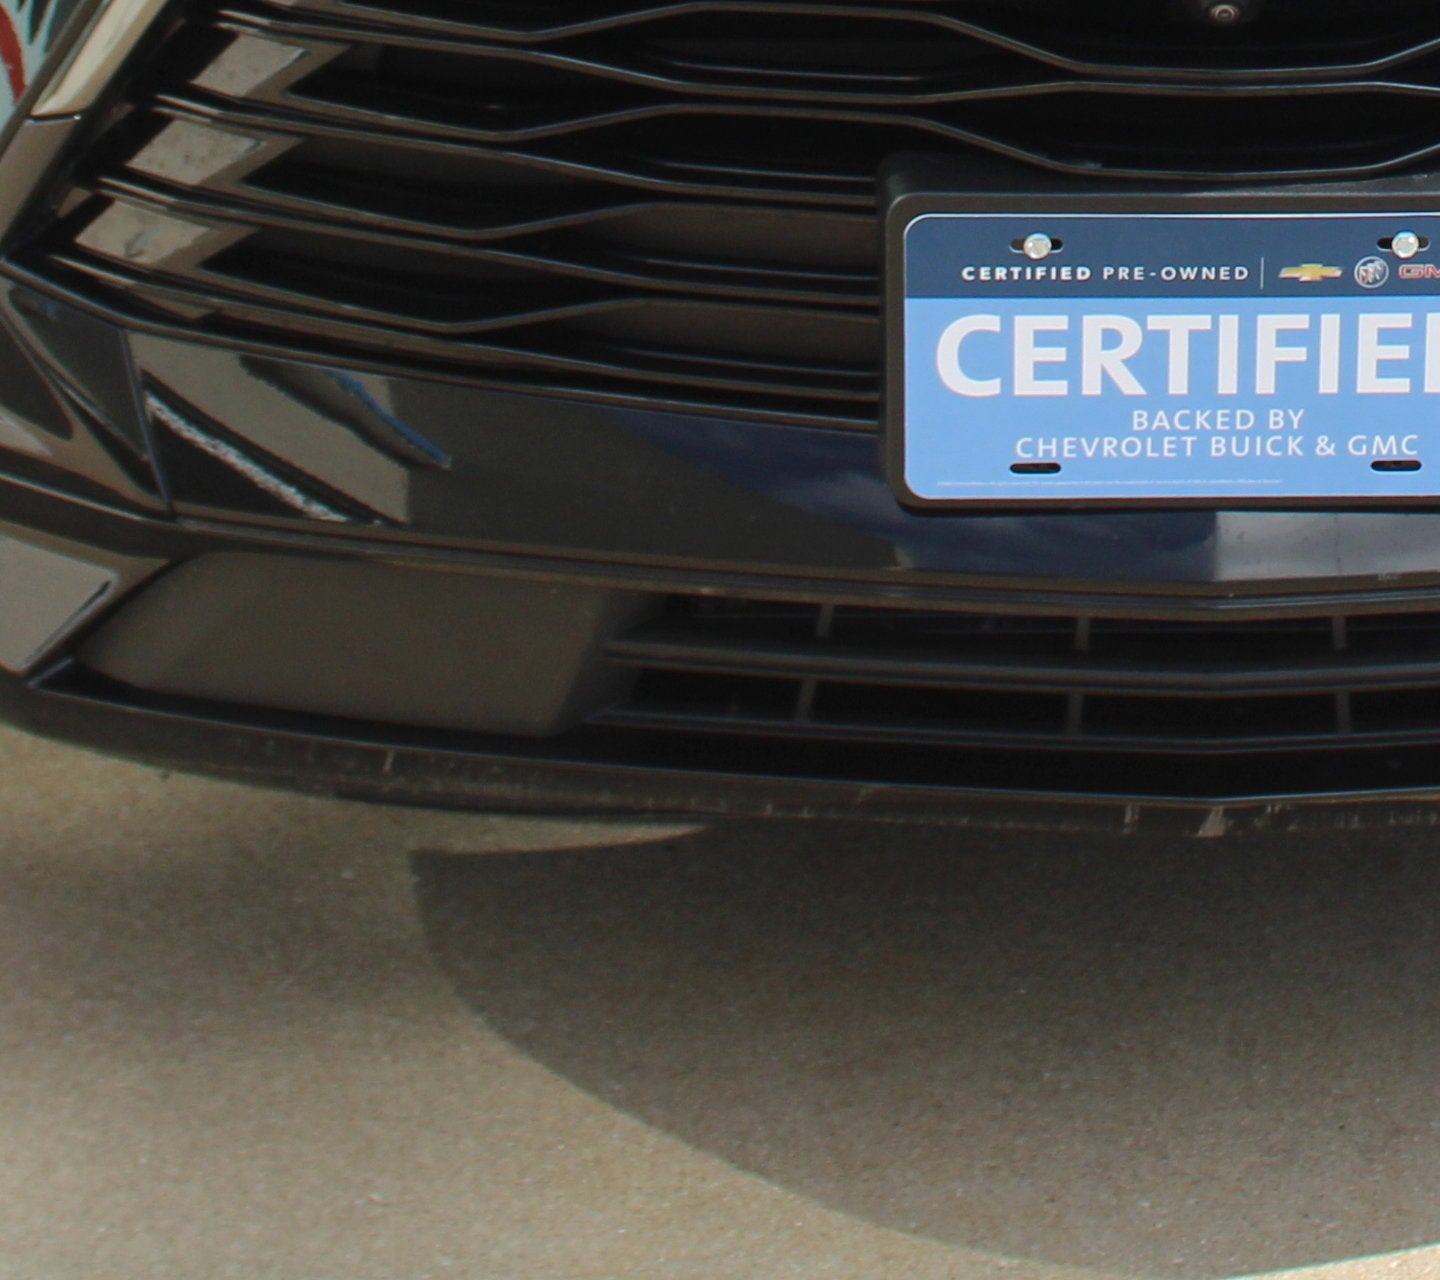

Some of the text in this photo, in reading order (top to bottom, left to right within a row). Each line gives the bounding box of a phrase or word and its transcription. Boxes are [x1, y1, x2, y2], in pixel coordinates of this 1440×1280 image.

[961, 265, 1250, 282] CERTIFIED PRE-OWNED
[1132, 408, 1306, 431] BACKED BY
[1015, 434, 1419, 458] CHEVROLET BUICK & GMC
